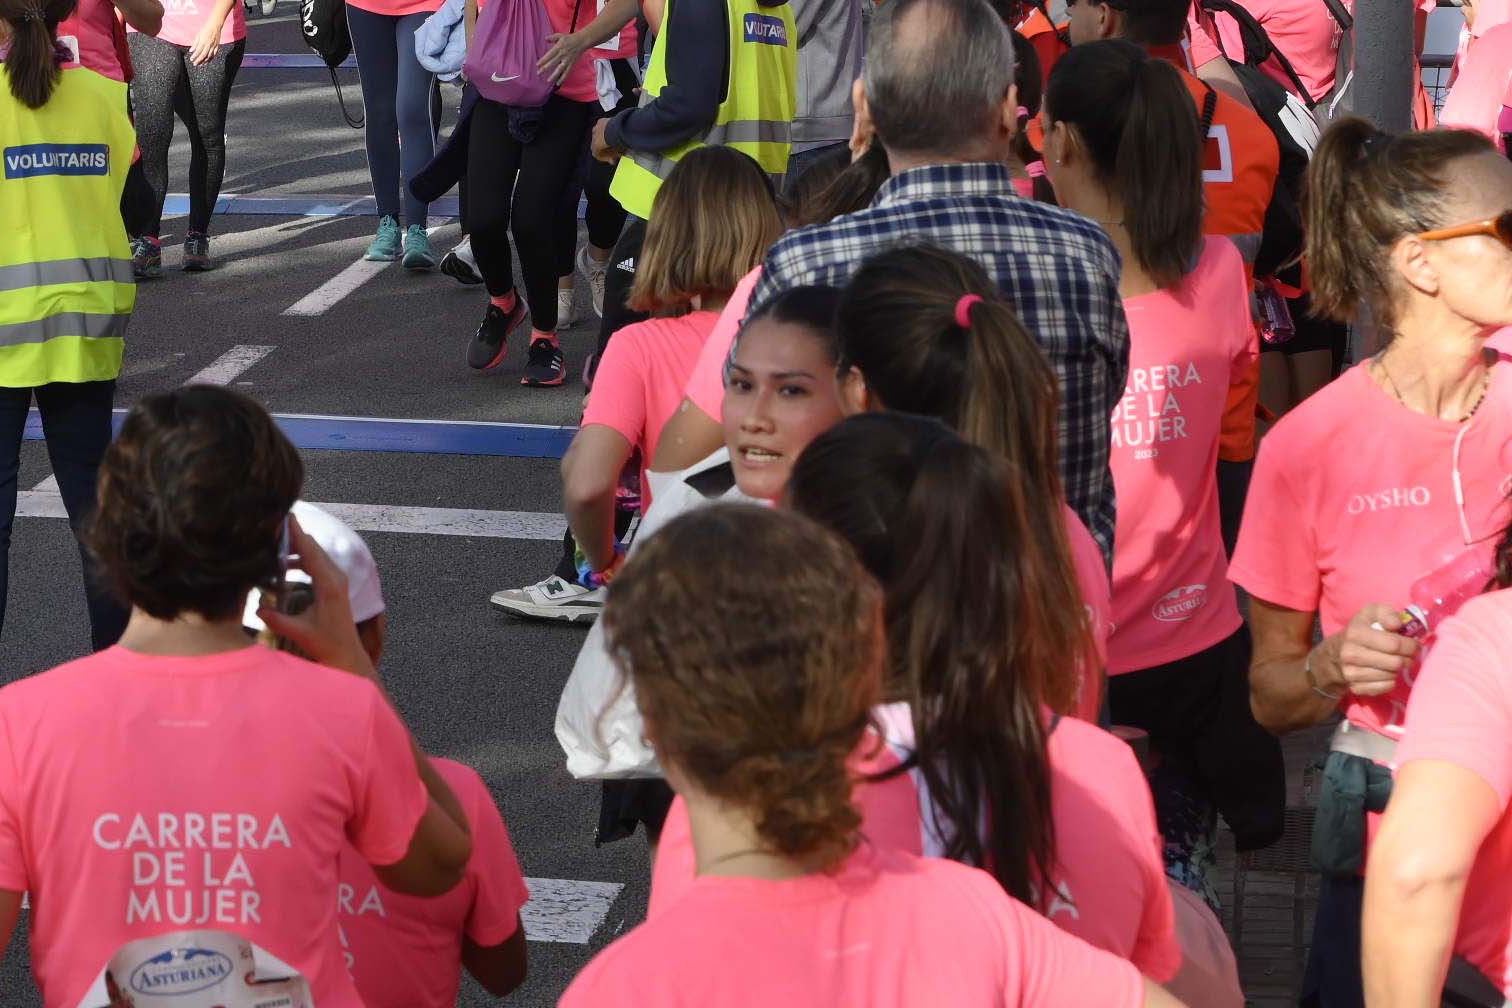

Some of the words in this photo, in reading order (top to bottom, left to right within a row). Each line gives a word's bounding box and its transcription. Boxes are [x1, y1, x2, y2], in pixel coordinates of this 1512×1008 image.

[6, 150, 106, 170] VOLUNTARIS
[1147, 393, 1181, 417] LA
[1347, 485, 1430, 516] OYSHO
[93, 812, 291, 850] CARRERA
[134, 853, 187, 887] DE
[204, 852, 254, 887] LA
[125, 890, 262, 925] MUJER
[138, 963, 225, 990] ASTURIANA
